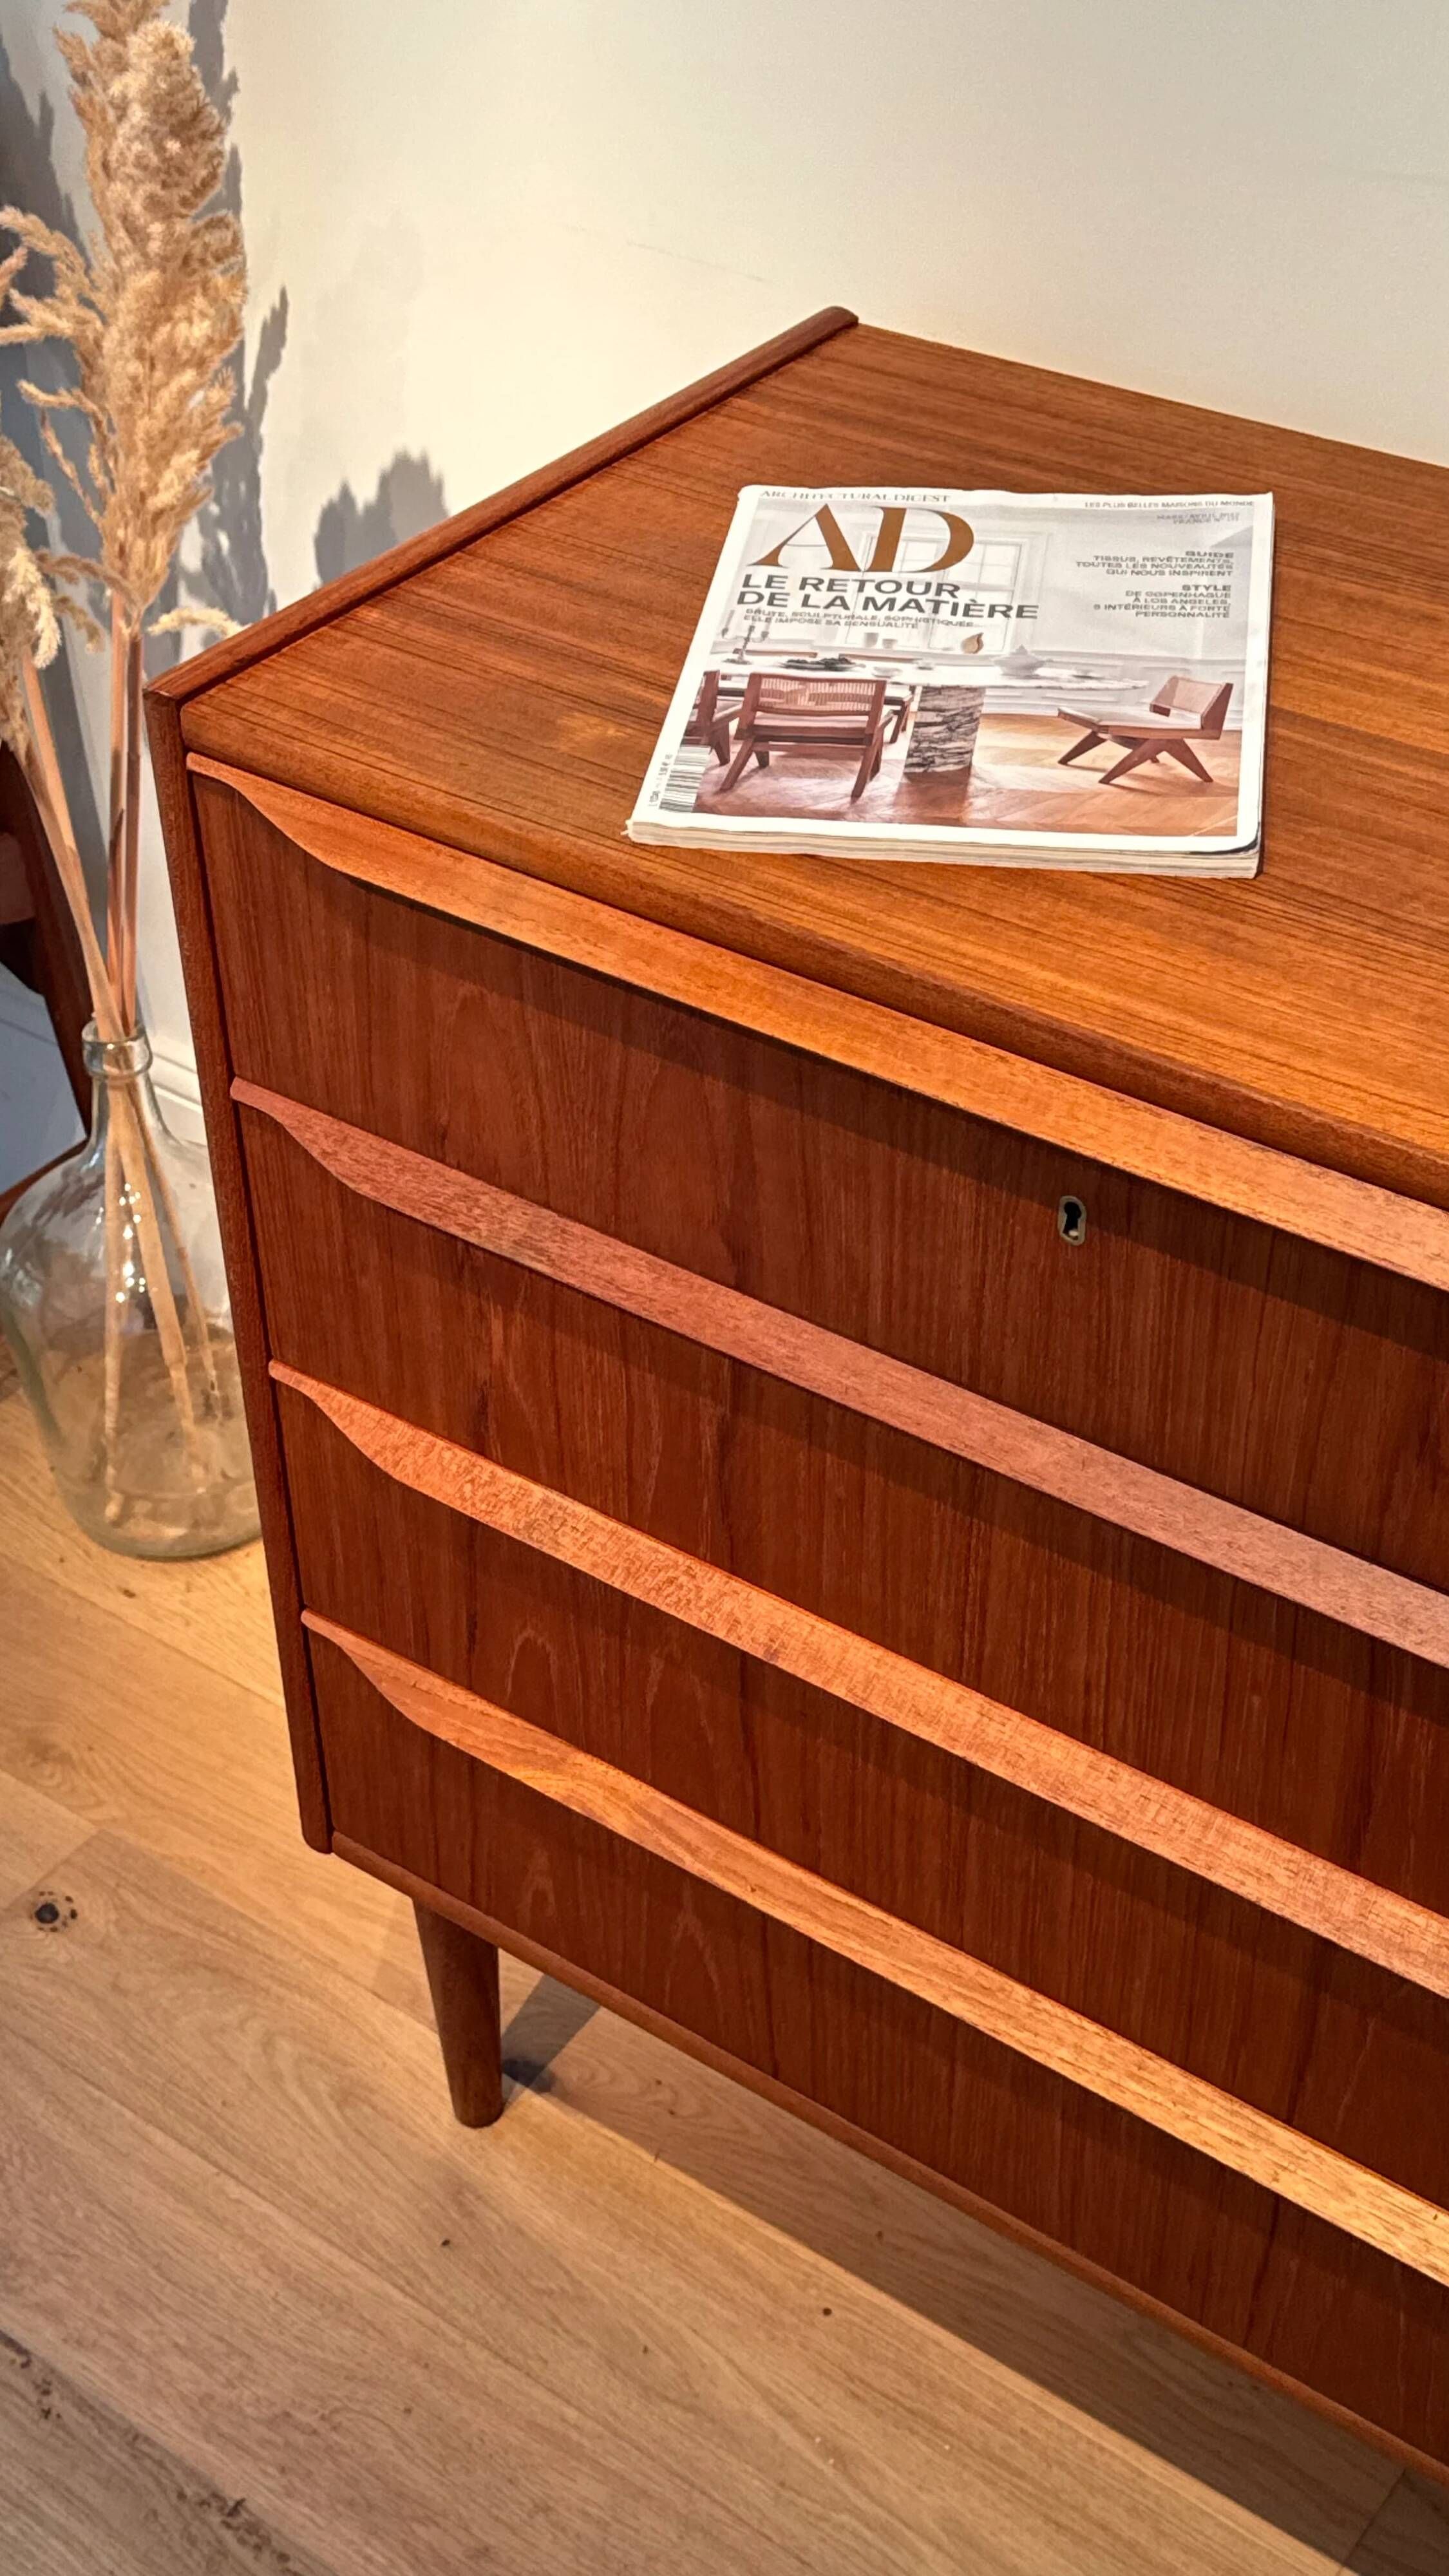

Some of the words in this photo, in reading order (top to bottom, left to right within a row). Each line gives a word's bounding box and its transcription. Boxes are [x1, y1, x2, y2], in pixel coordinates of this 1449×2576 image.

[895, 494, 951, 502] DIGEST
[746, 503, 974, 574] AD
[742, 573, 789, 590] LE
[798, 576, 961, 599] RETOUR
[1145, 591, 1231, 599] COPENHAGUE
[737, 590, 791, 607] DE
[801, 593, 852, 611] LA
[862, 596, 1039, 620] MATIÈRE
